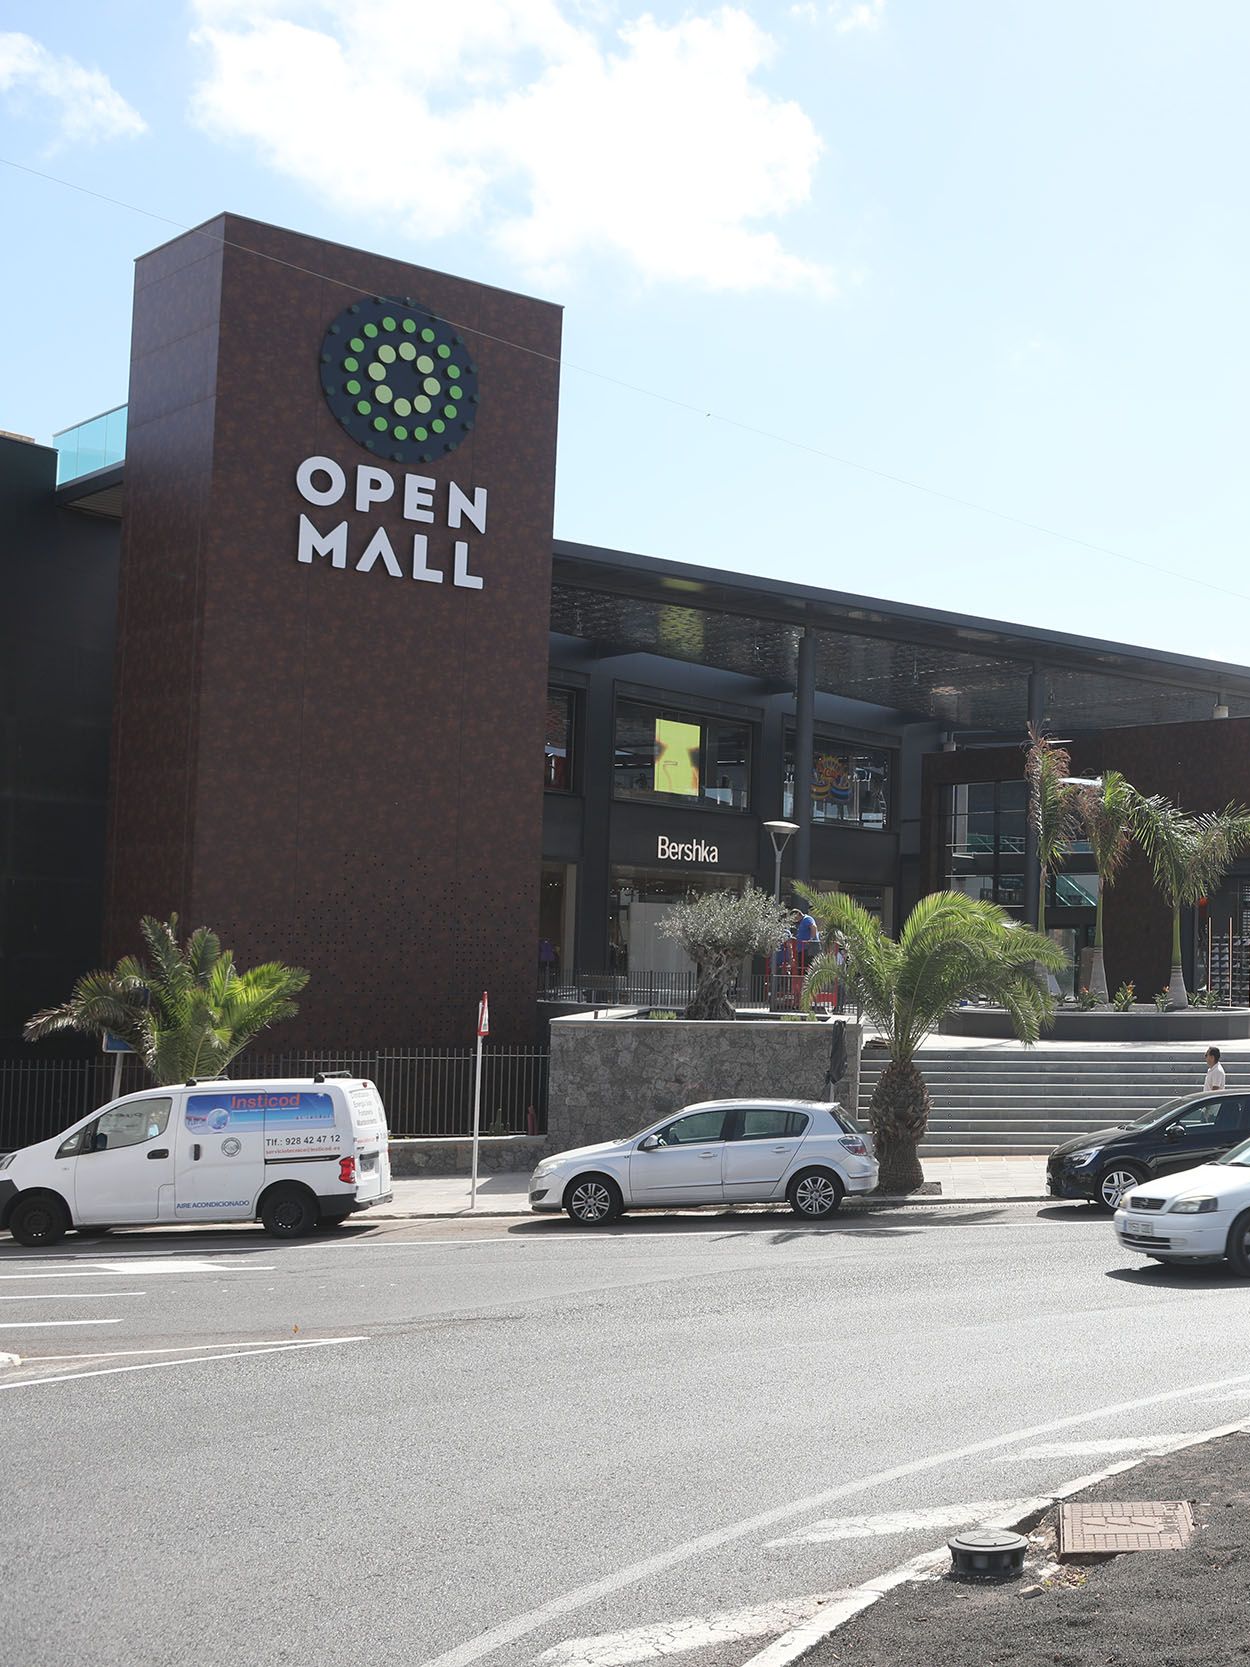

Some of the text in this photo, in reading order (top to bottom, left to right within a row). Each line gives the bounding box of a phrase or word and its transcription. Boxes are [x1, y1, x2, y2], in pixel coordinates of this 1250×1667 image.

[296, 455, 488, 535] OPEN
[297, 512, 484, 590] MALL
[657, 835, 719, 863] Bershka
[230, 1093, 301, 1109] Insticod
[285, 1136, 301, 1146] 928
[303, 1135, 315, 1144] 42
[317, 1135, 327, 1144] 47
[330, 1134, 341, 1143] 12
[176, 1200, 250, 1209] AIRE ACONDICIONADO
